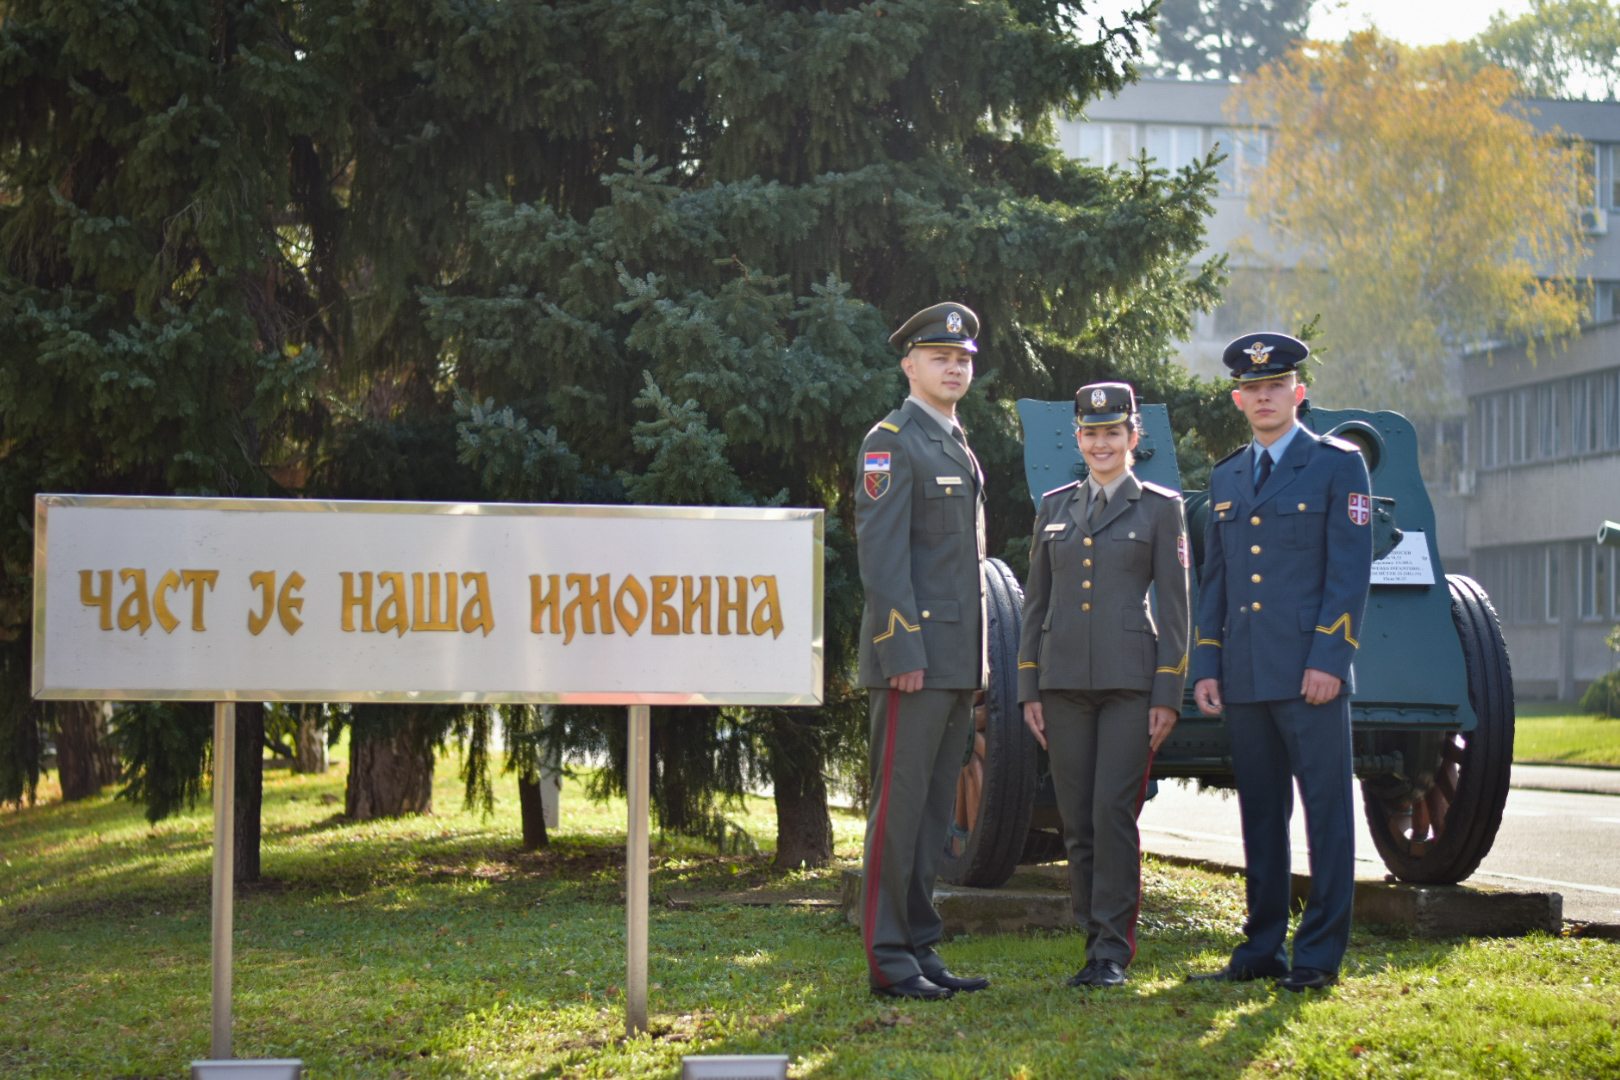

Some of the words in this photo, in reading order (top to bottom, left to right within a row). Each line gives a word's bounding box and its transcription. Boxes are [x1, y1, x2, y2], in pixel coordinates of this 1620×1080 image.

[79, 568, 219, 636] ЧАСТ
[248, 570, 306, 637] ЈЕ
[340, 570, 496, 638] НАША
[529, 573, 785, 646] ИМОВИНА
